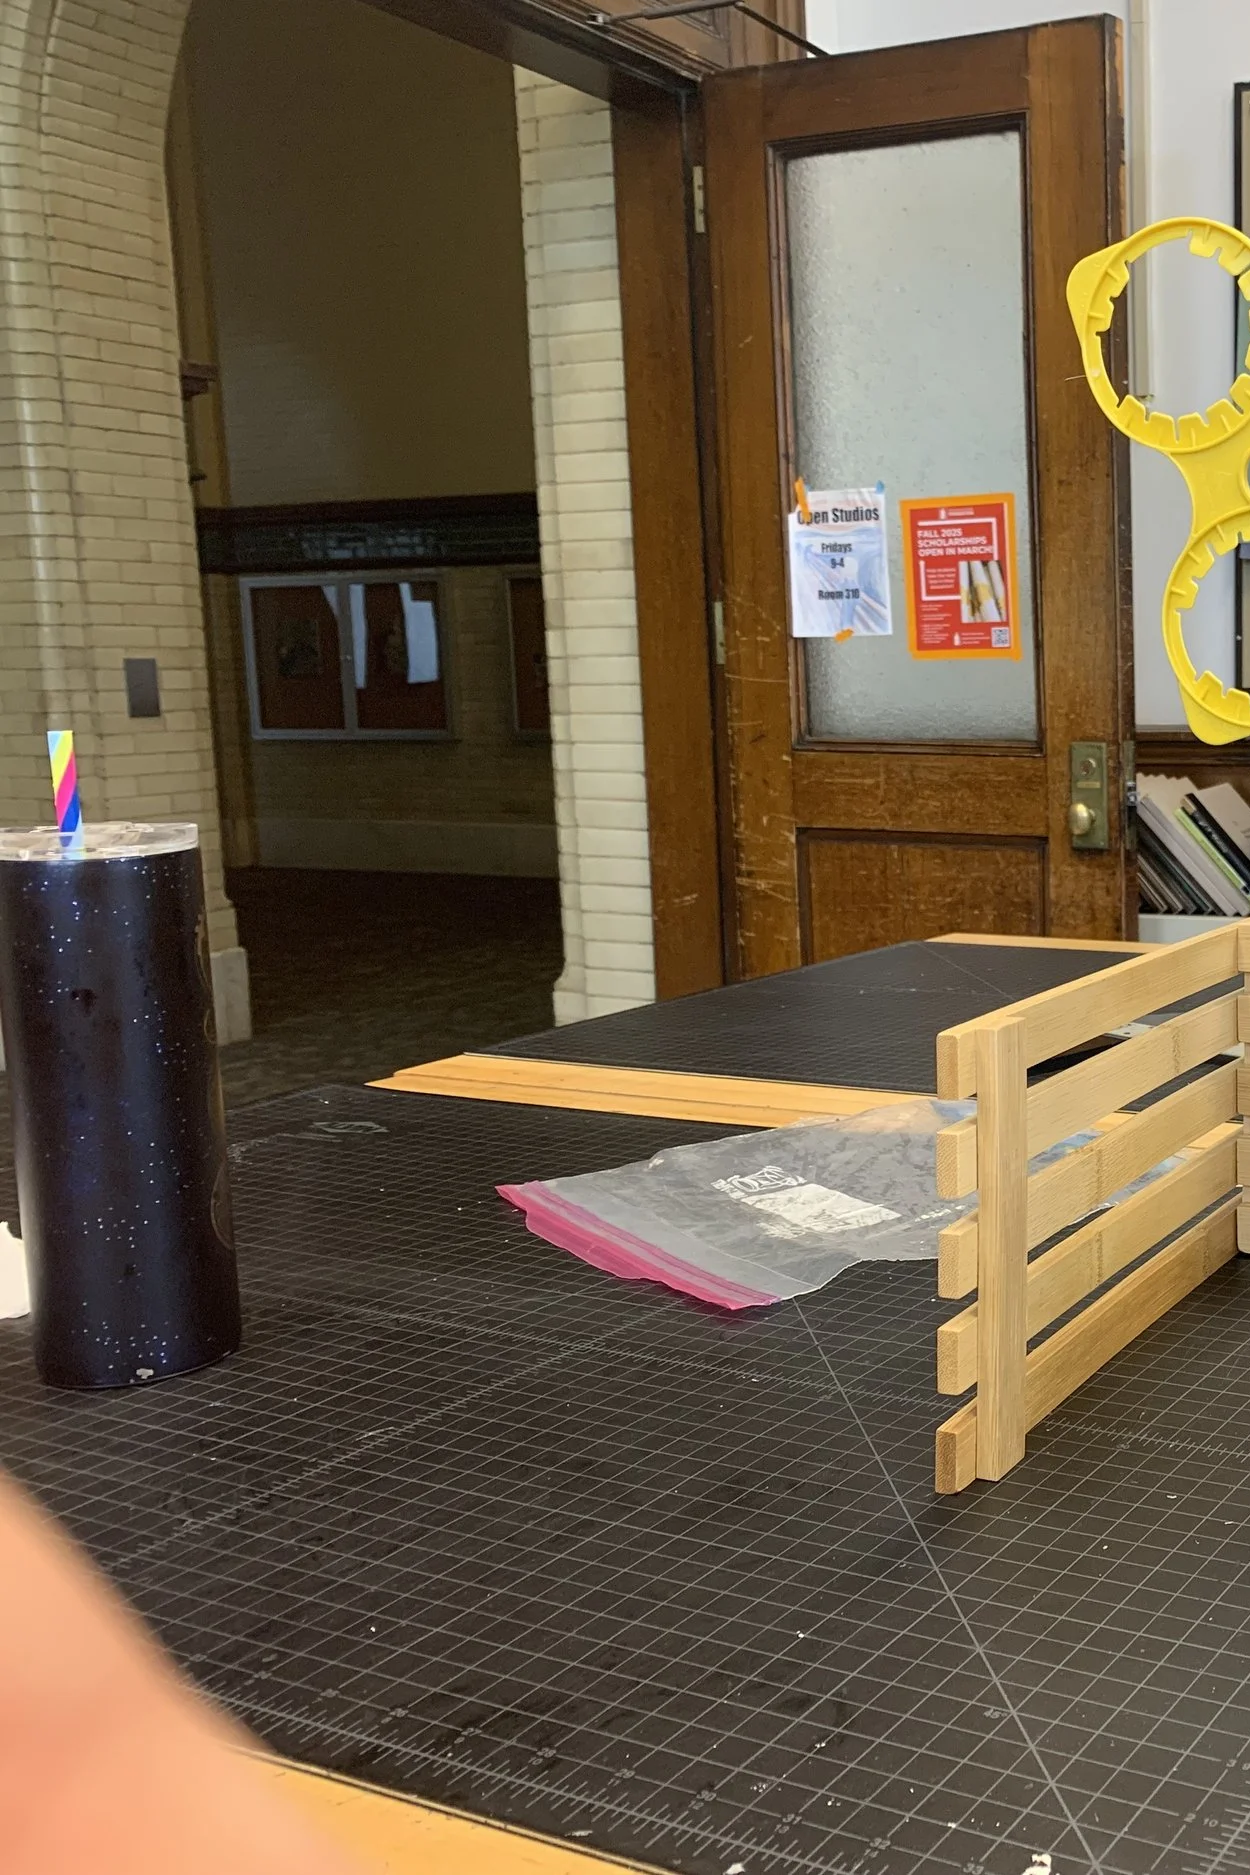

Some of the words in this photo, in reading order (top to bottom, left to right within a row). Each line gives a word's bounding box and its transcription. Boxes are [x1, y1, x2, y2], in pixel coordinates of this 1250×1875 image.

[832, 507, 880, 523] Studios
[917, 530, 939, 538] FALL
[917, 536, 987, 548] SCHOLARSHIPS
[821, 542, 852, 554] Fridays
[918, 548, 944, 557] OPEN
[945, 547, 957, 556] IN
[830, 558, 845, 569] 9-4
[818, 590, 843, 600] Room
